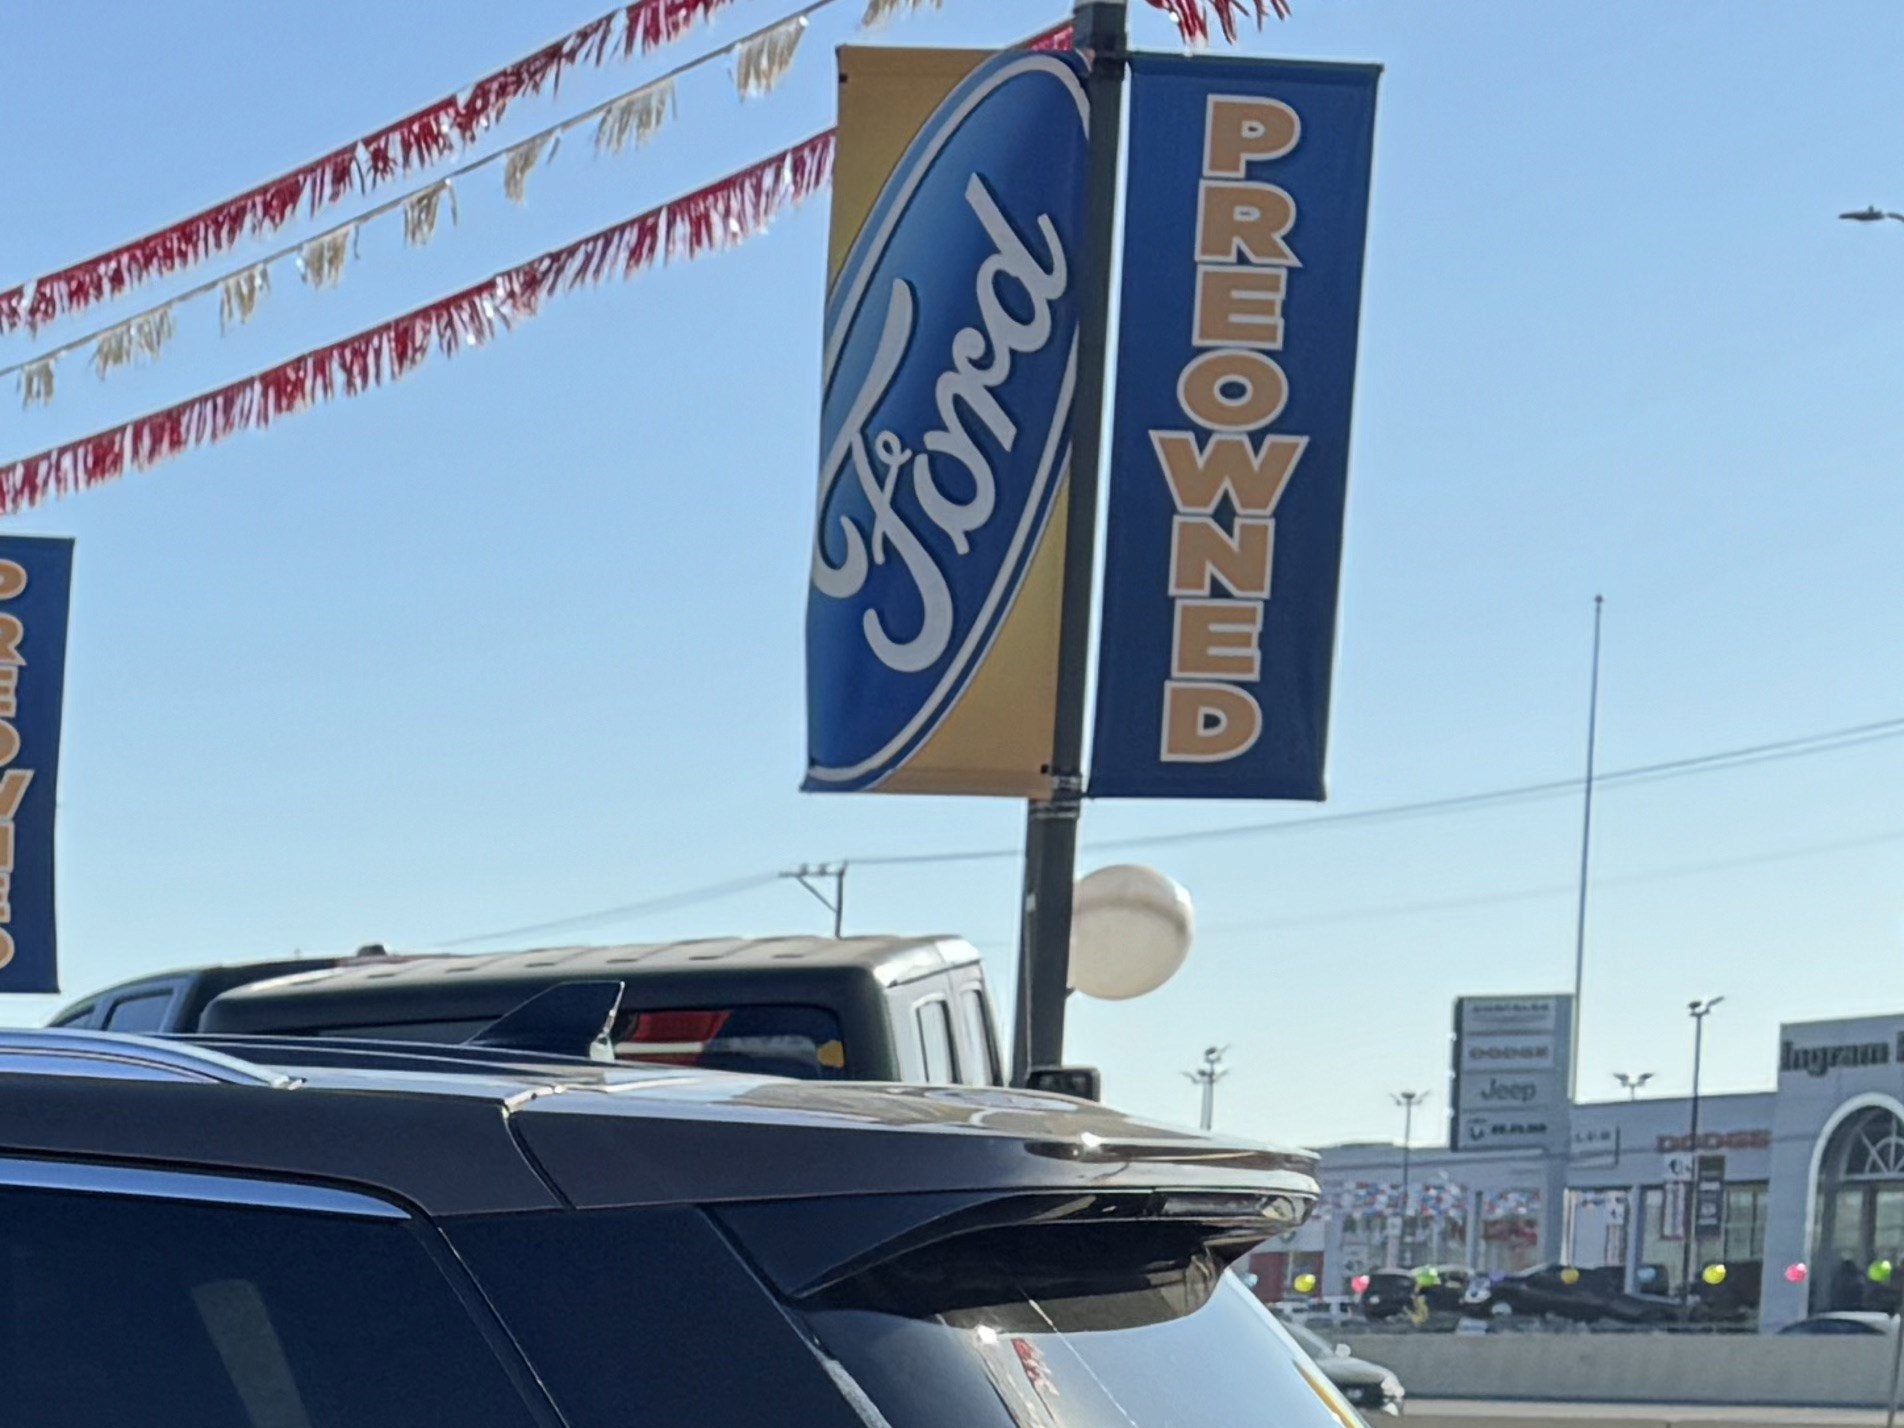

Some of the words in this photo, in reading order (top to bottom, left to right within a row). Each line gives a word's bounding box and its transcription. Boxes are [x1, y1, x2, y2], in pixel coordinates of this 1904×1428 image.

[811, 172, 1068, 673] Ford
[1148, 94, 1310, 763] PREOWNED
[1480, 1078, 1538, 1102] Jeep
